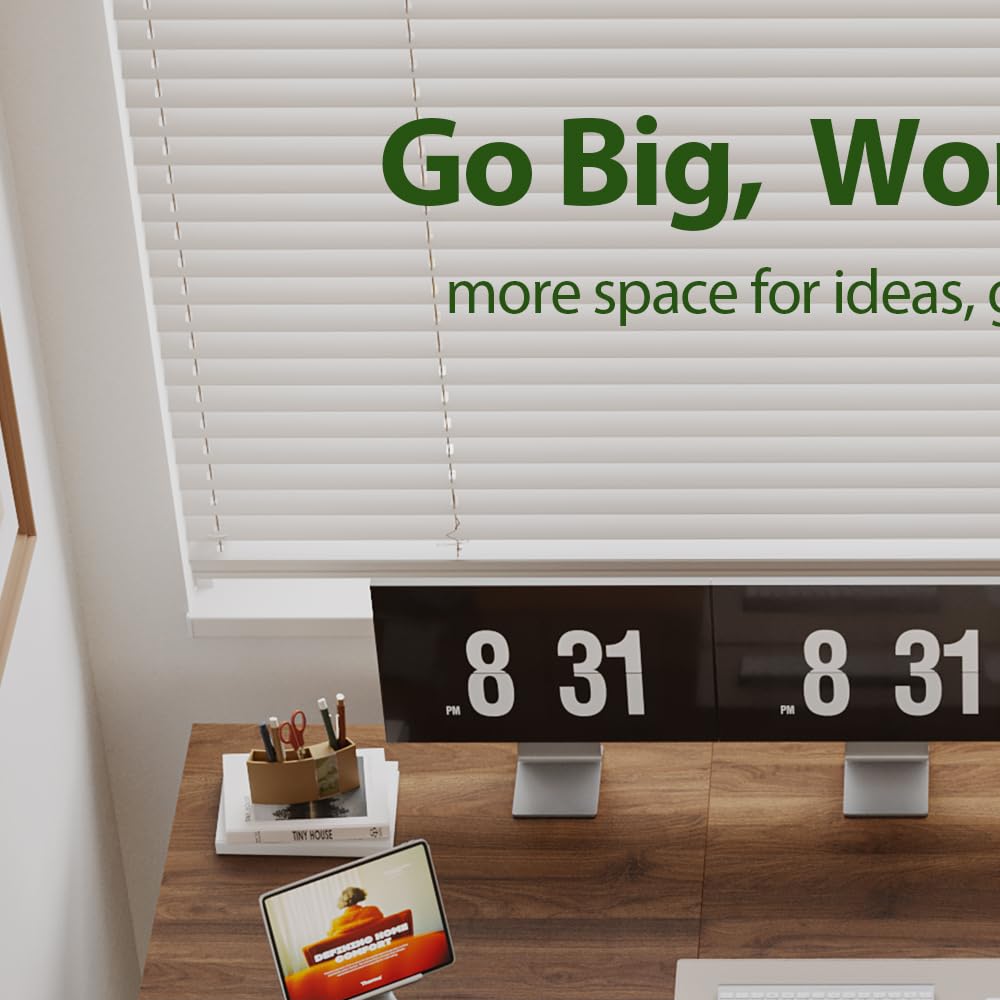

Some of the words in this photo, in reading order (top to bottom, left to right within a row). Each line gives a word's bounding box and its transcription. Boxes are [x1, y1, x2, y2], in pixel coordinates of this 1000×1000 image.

[445, 704, 461, 715] PM
[465, 629, 515, 717] 8
[557, 629, 645, 717] 31
[780, 704, 795, 715] PM
[803, 629, 850, 717] 8
[894, 629, 979, 717] 31
[292, 830, 308, 842] TINY
[309, 829, 334, 841] HOUSE
